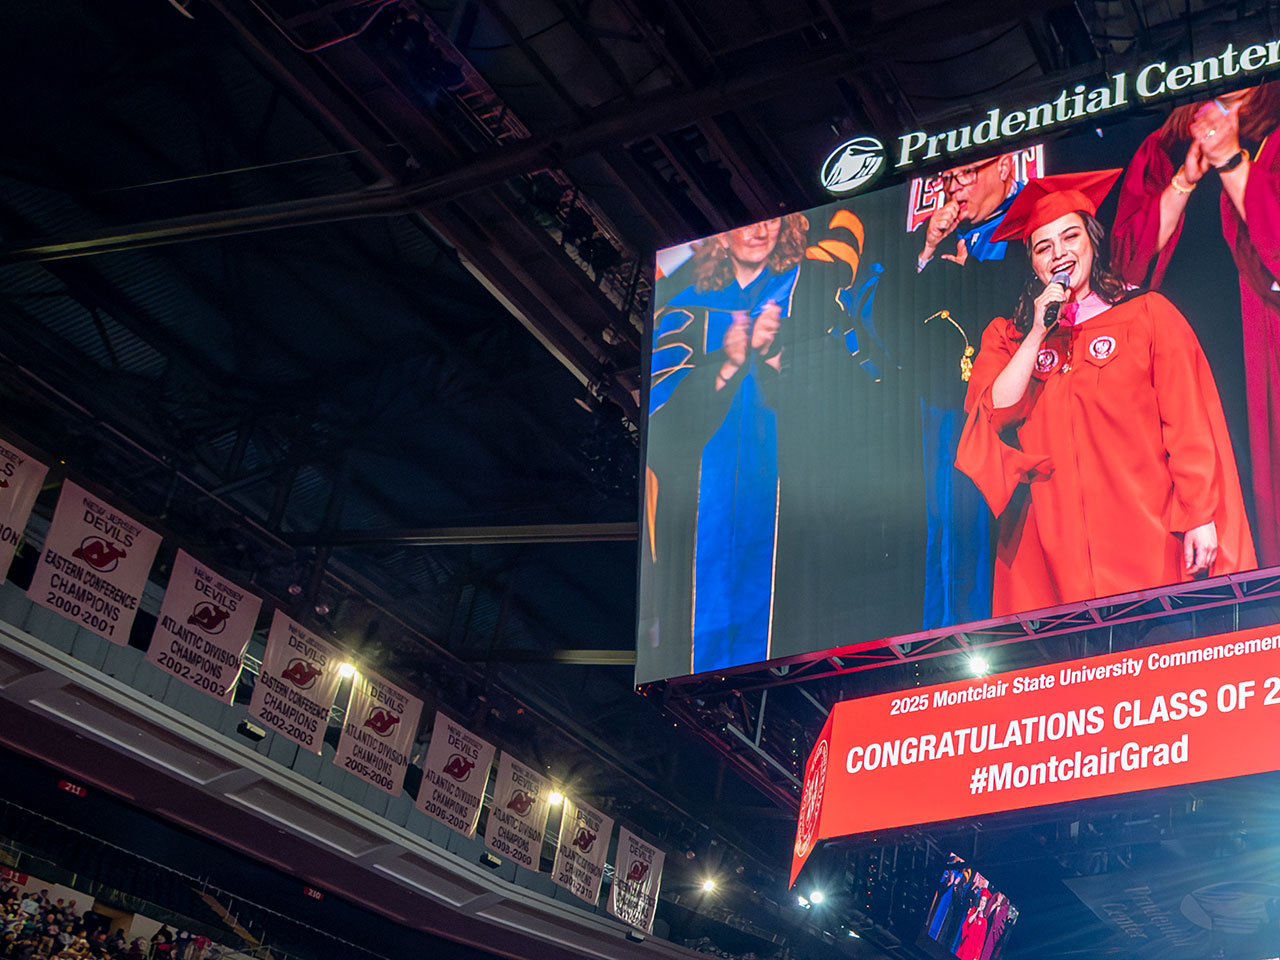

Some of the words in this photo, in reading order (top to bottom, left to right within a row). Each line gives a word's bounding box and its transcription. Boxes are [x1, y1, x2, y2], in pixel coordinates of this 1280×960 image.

[896, 73, 1127, 167] Prudential
[83, 498, 105, 516] NEW
[106, 512, 142, 536] JERSEY
[84, 511, 134, 547] DEVILS
[44, 549, 82, 580] EASTERN
[84, 570, 138, 610] CONFERENCE
[50, 574, 120, 621] CHAMPIONS
[194, 579, 236, 612] DEVILS
[46, 592, 115, 636] 2000-2001
[160, 615, 202, 650] ATLANTIC
[204, 641, 240, 670] DIVISION
[170, 640, 222, 680] CHAMPIONS
[288, 636, 326, 666] DEVILS
[157, 652, 225, 697] 2002-2003
[890, 694, 930, 717] 2025
[932, 680, 1009, 709] Montclair
[1012, 673, 1055, 694] State
[1060, 659, 1142, 688] University
[264, 692, 317, 732] CHAMPIONS
[288, 688, 330, 722] CONFERENCE
[370, 686, 404, 714] DEVILS
[259, 708, 314, 746] 2002-2003
[346, 724, 377, 752] ATLANTIC
[378, 743, 408, 766] DIVISION
[846, 706, 1102, 774] CONGRATULATIONS
[1113, 688, 1208, 730] CLASS
[1216, 682, 1258, 713] OF
[352, 744, 392, 776] CHAMPIONS
[448, 734, 478, 760] DEVILS
[970, 735, 1189, 795] #MontclairGrad
[345, 757, 393, 790] 2005-2006
[424, 769, 454, 793] ATLANTIC
[512, 772, 540, 794] DEVILS
[424, 801, 470, 834] 2006-2007
[432, 789, 468, 818] CHAMPIONS
